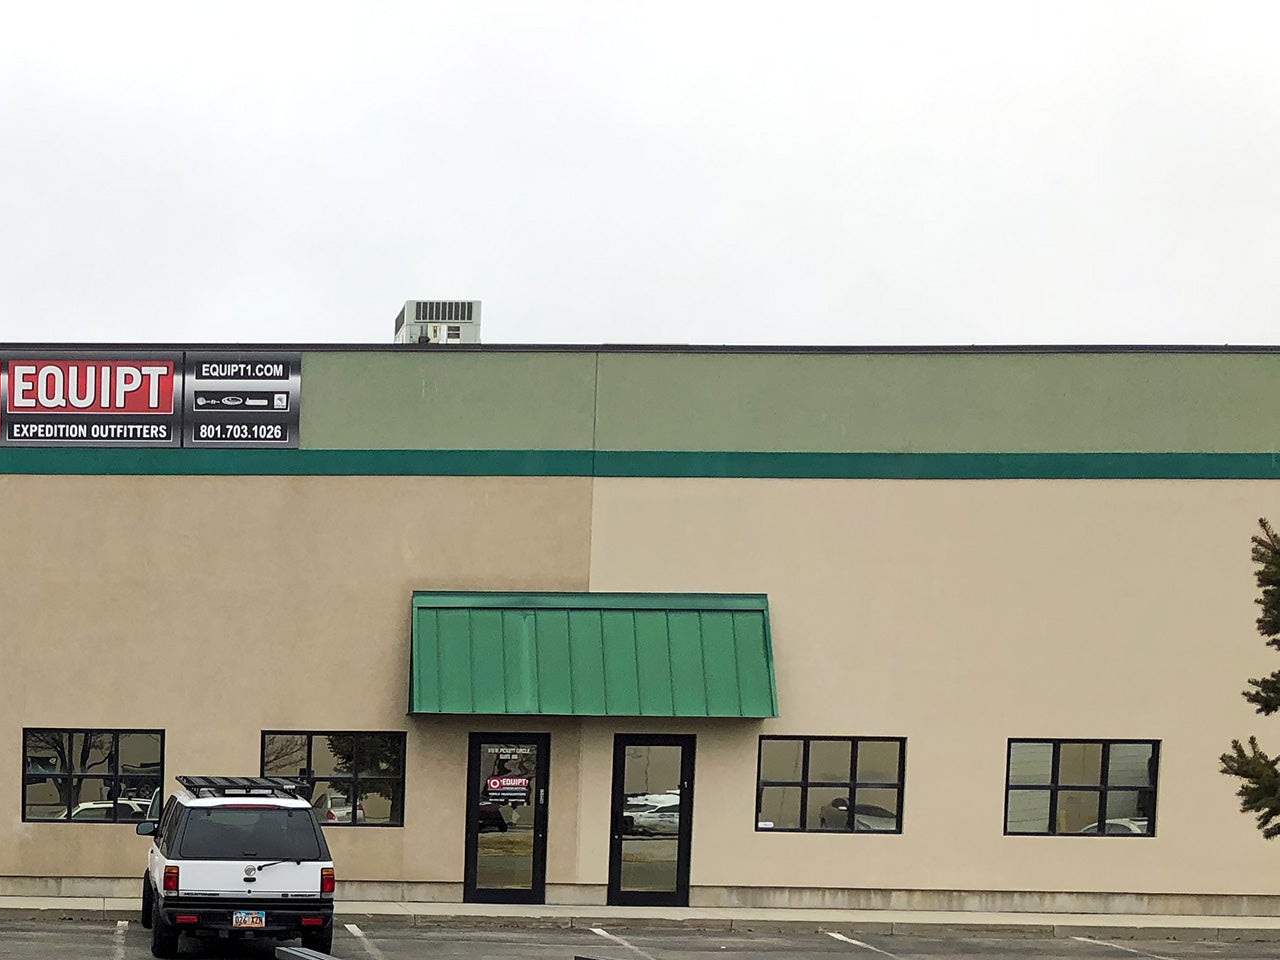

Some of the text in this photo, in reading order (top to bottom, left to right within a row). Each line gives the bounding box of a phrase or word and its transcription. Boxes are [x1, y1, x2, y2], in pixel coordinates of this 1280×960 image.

[201, 363, 283, 377] EQUIPT1.COM
[13, 365, 168, 408] EQUIPT
[13, 423, 167, 438] EXPEDITION OUTFITTERS
[199, 424, 282, 439] 801.703.1026
[502, 778, 527, 786] EQUIPT
